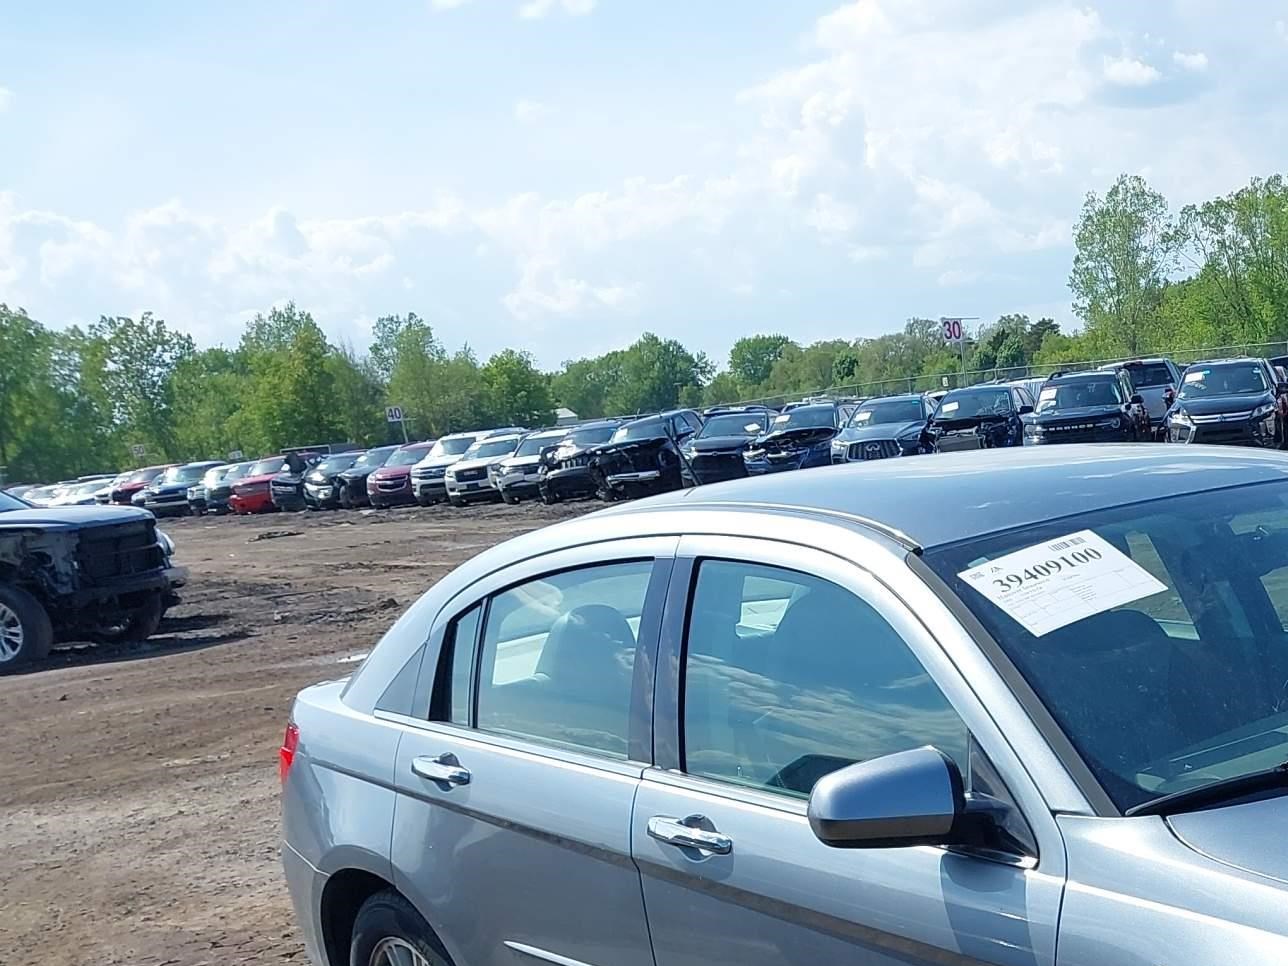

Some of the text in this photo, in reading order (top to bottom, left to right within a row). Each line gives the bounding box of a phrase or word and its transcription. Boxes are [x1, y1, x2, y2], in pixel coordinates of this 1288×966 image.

[943, 320, 961, 340] 30
[387, 407, 401, 420] 40
[993, 547, 1103, 593] 39409100
